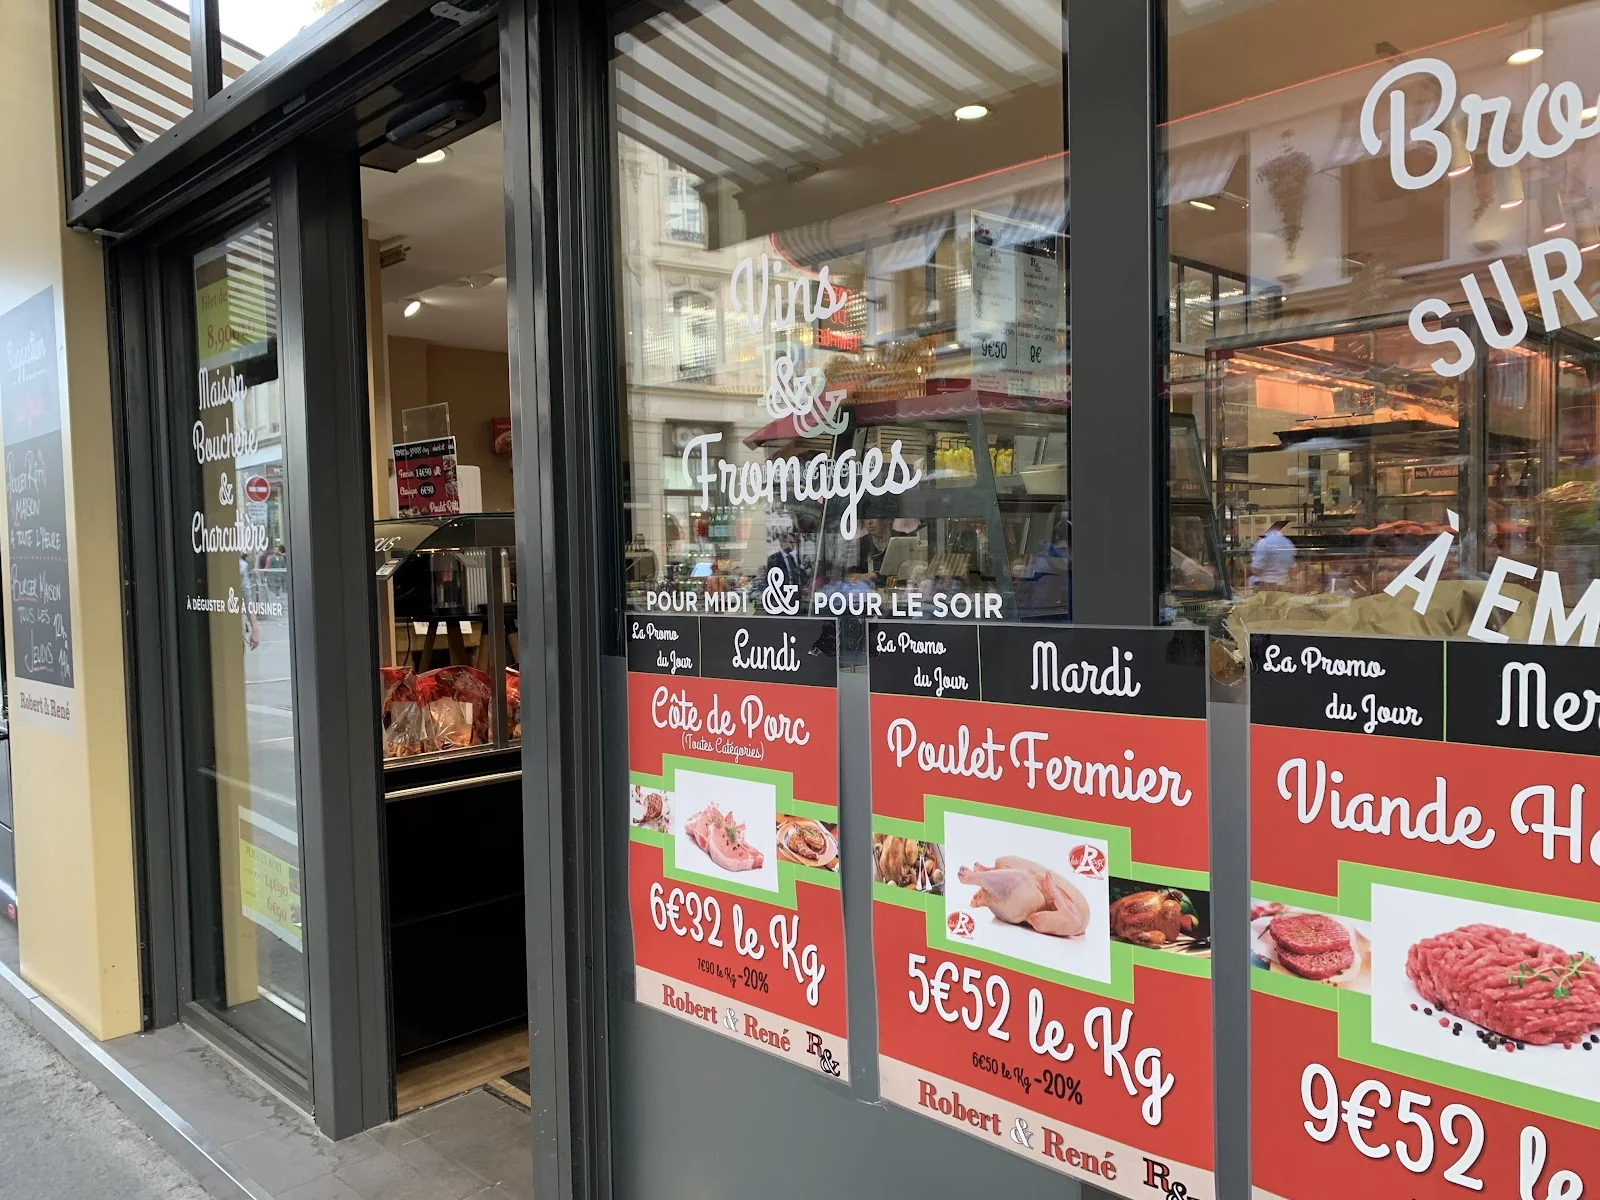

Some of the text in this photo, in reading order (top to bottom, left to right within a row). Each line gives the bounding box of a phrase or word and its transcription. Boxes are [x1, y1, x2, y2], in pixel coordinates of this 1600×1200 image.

[730, 253, 847, 334] Vins
[1408, 237, 1598, 378] SUR
[981, 338, 1042, 363] 9€50 8€
[199, 366, 247, 410] Maison
[766, 355, 814, 418] &
[192, 417, 258, 464] Bouchère
[219, 472, 234, 505] &
[682, 431, 922, 541] Fromages
[191, 510, 269, 554] Charcutière
[1384, 508, 1460, 616] À
[192, 596, 226, 612] DÉGUSTER
[227, 587, 240, 614] &
[241, 598, 247, 614] À
[248, 601, 283, 616] CUISINER
[646, 566, 1004, 619] POUR MIDI & POUR LE SOIR
[632, 622, 679, 641] La Promo
[732, 628, 801, 672] Lundi
[876, 630, 947, 655] La Promo
[656, 650, 693, 675] du Jour
[913, 666, 969, 697] du Jour
[1030, 641, 1141, 697] Mardi
[1263, 644, 1386, 678] La Promo
[20, 692, 43, 710] Robert
[51, 699, 71, 721] René
[651, 686, 811, 746] Côte de Porc
[1325, 692, 1423, 734] du Jour
[887, 717, 1193, 807] Poulet Fermier
[1277, 757, 1497, 850] Viande
[267, 896, 287, 921] 6€90
[650, 882, 827, 1007] 6€32 le Kg
[716, 964, 724, 978] le
[725, 967, 737, 988] Kg
[738, 966, 769, 994] -20%
[661, 983, 791, 1052] Robert & René
[907, 952, 1175, 1126] 5€52 le Kg
[972, 1052, 1083, 1105] 6€50 le Kg -20%
[917, 1078, 1117, 1181] Robert & René
[1300, 1062, 1484, 1191] 9€52
